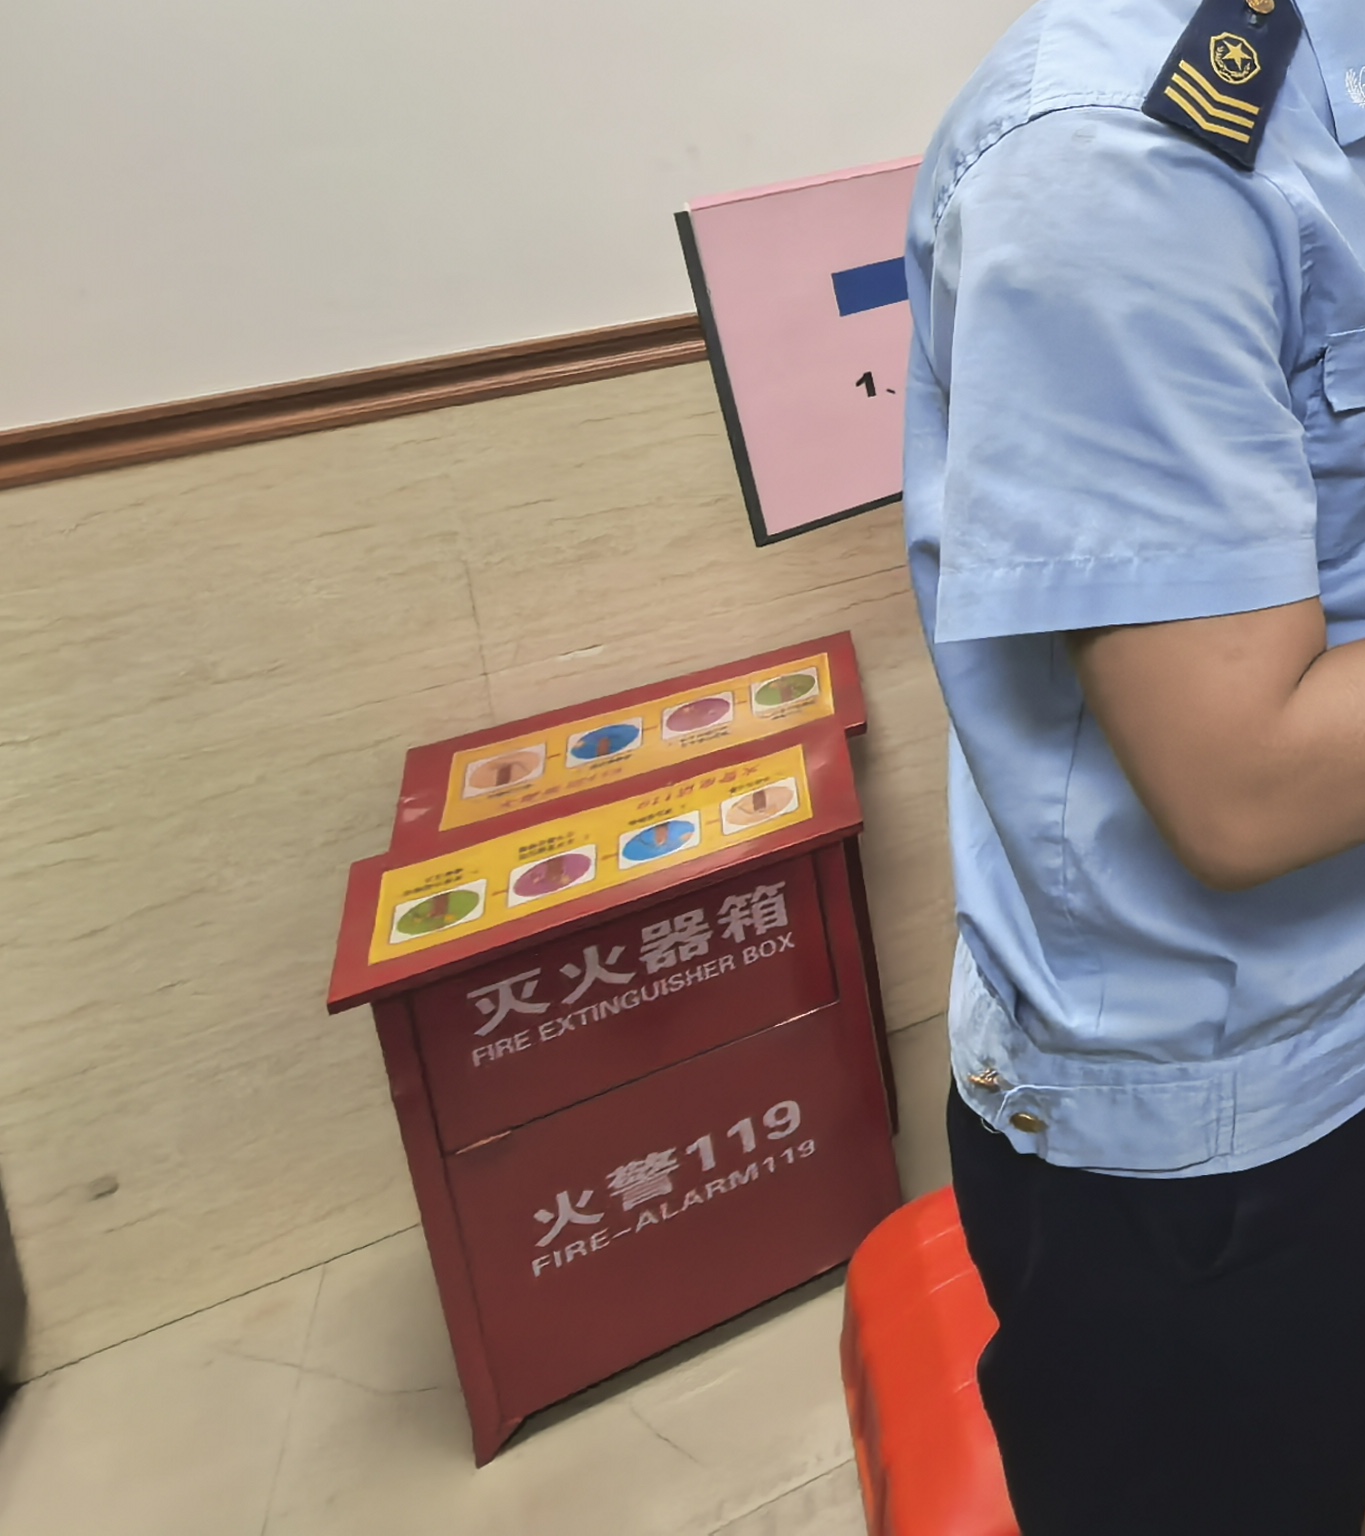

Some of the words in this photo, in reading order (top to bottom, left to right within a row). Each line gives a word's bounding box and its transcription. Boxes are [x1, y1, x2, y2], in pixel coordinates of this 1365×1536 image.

[466, 881, 787, 1037] 灭火器箱
[471, 1029, 532, 1068] FIRE
[538, 954, 736, 1044] EXTINGUISHER
[743, 931, 797, 967] BOX
[531, 1139, 816, 1278] FIRE-ALARM119
[533, 1100, 802, 1248] 火警119
